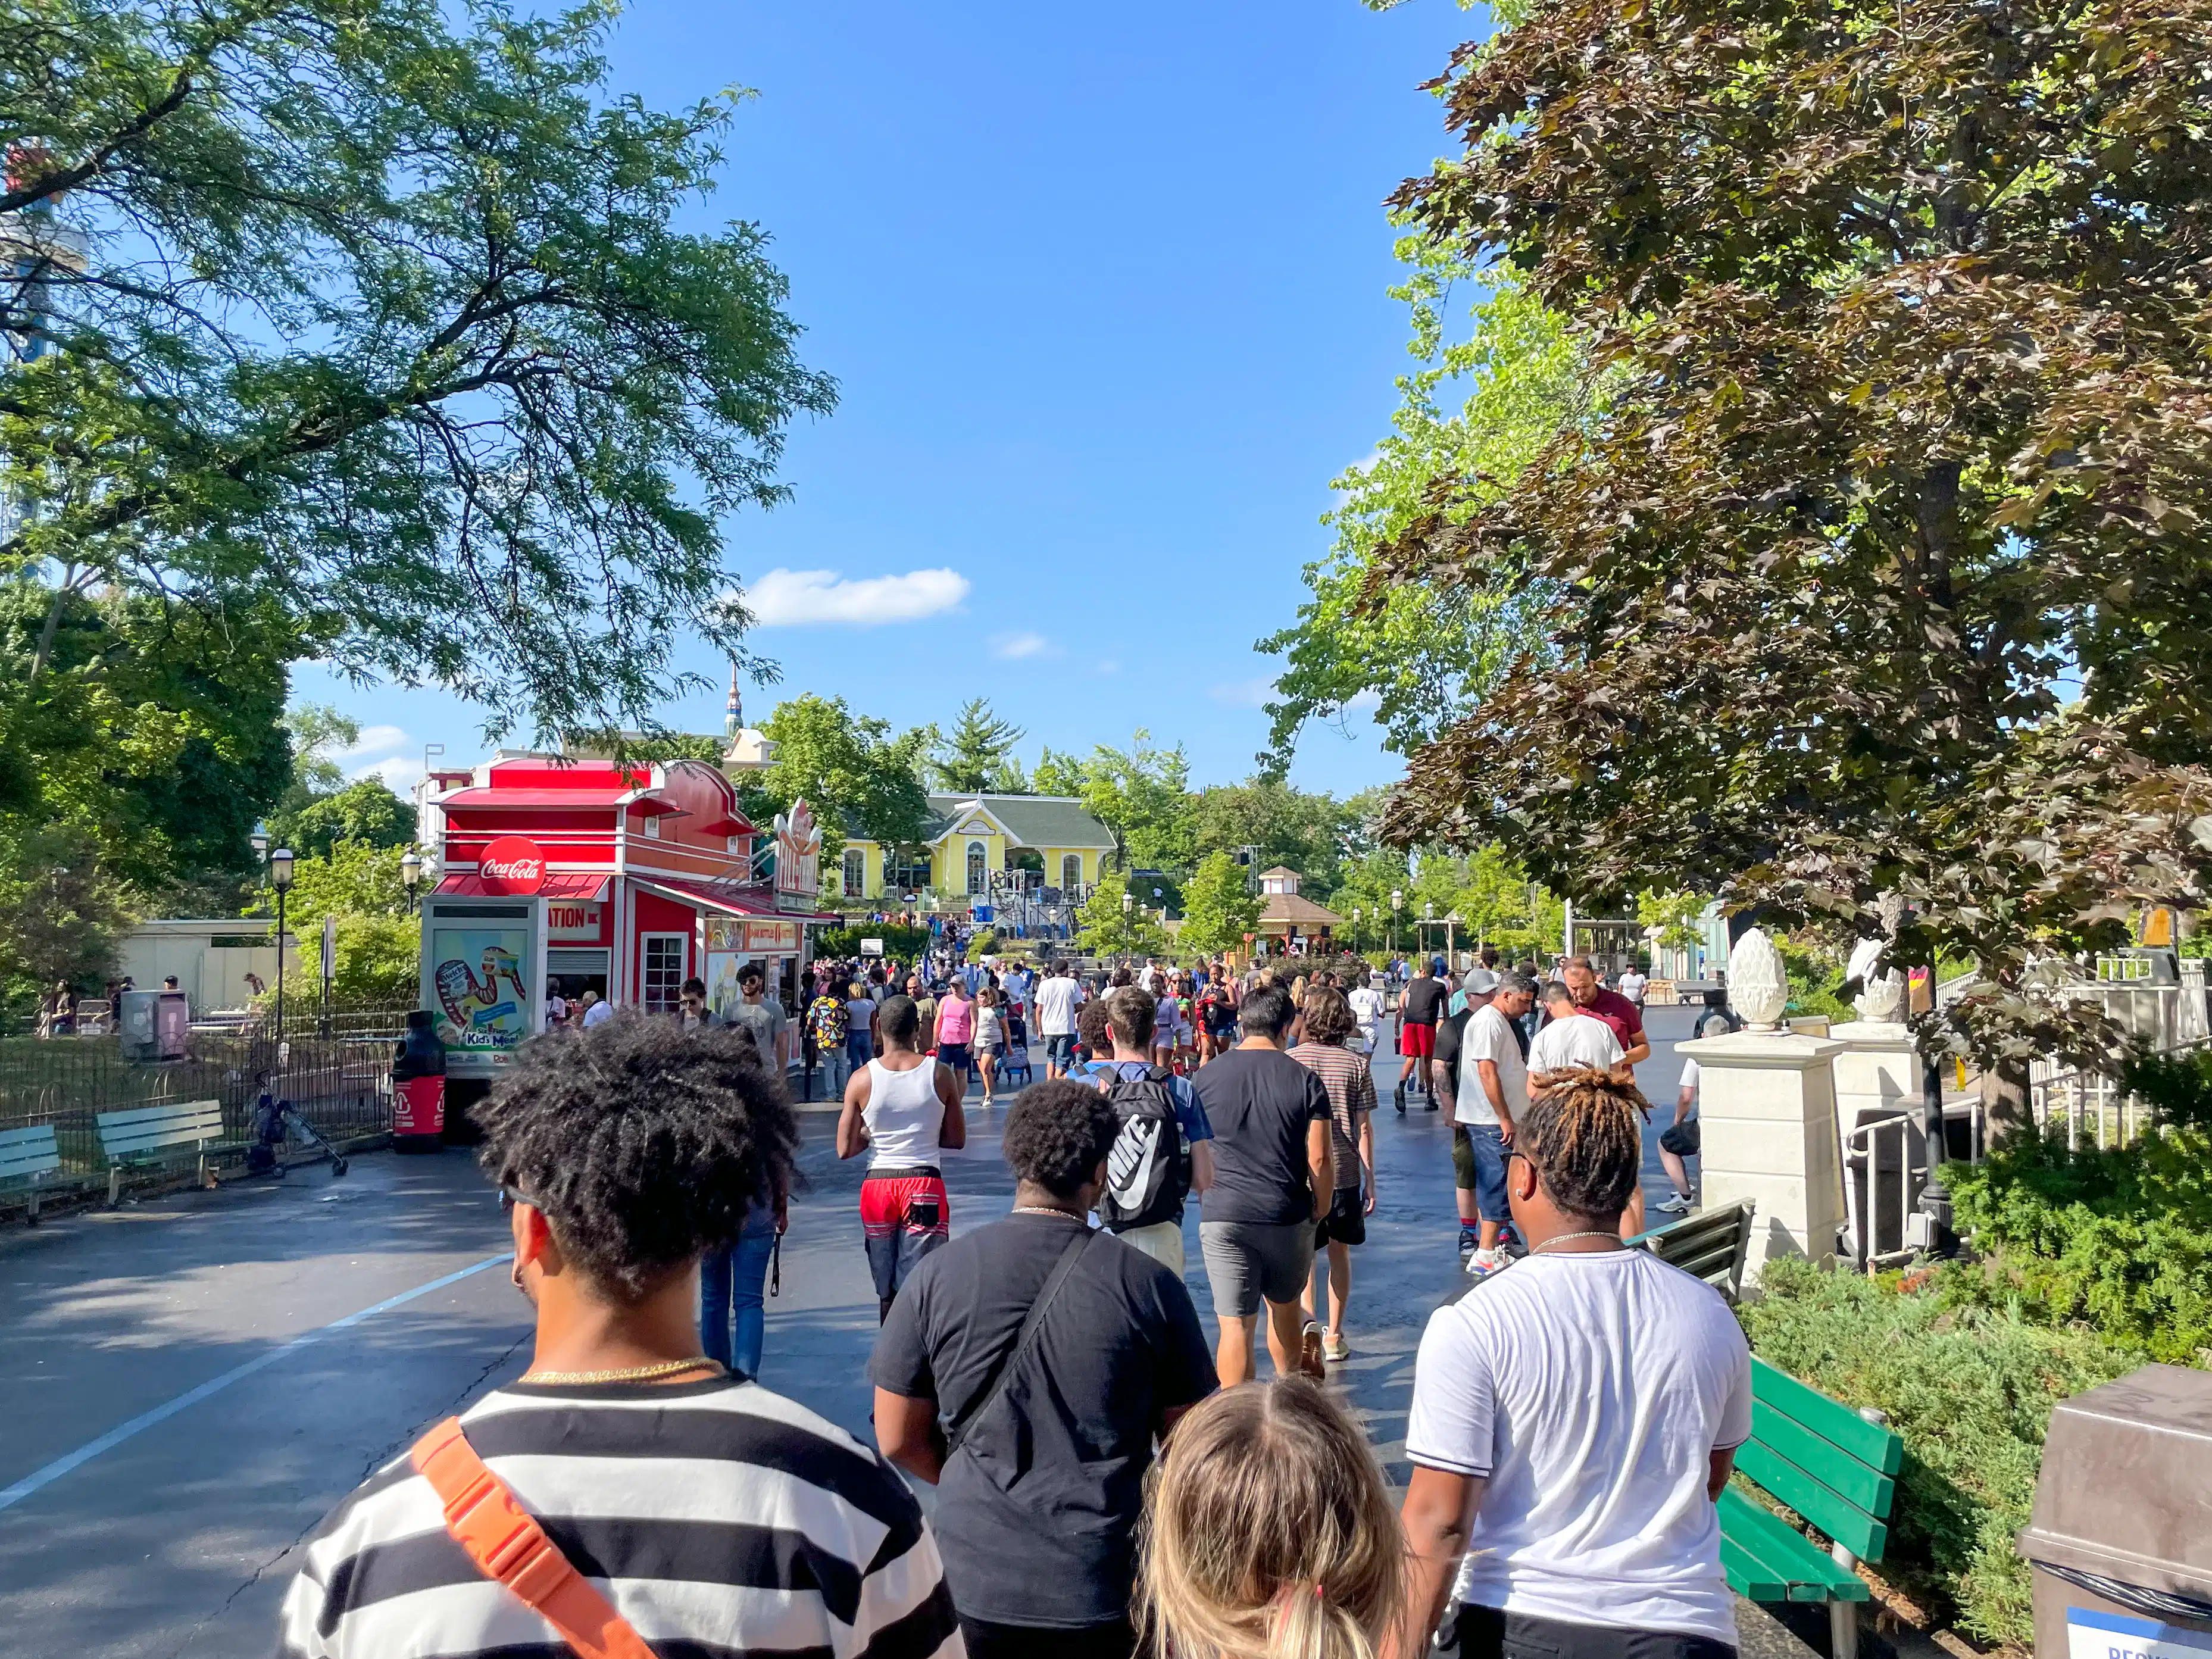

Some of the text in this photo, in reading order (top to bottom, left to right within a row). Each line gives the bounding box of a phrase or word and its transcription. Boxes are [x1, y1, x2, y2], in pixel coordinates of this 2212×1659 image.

[480, 859, 542, 879] Coca-Cola
[467, 1033, 489, 1043] Kid's
[1107, 1114, 1152, 1187] NIKE
